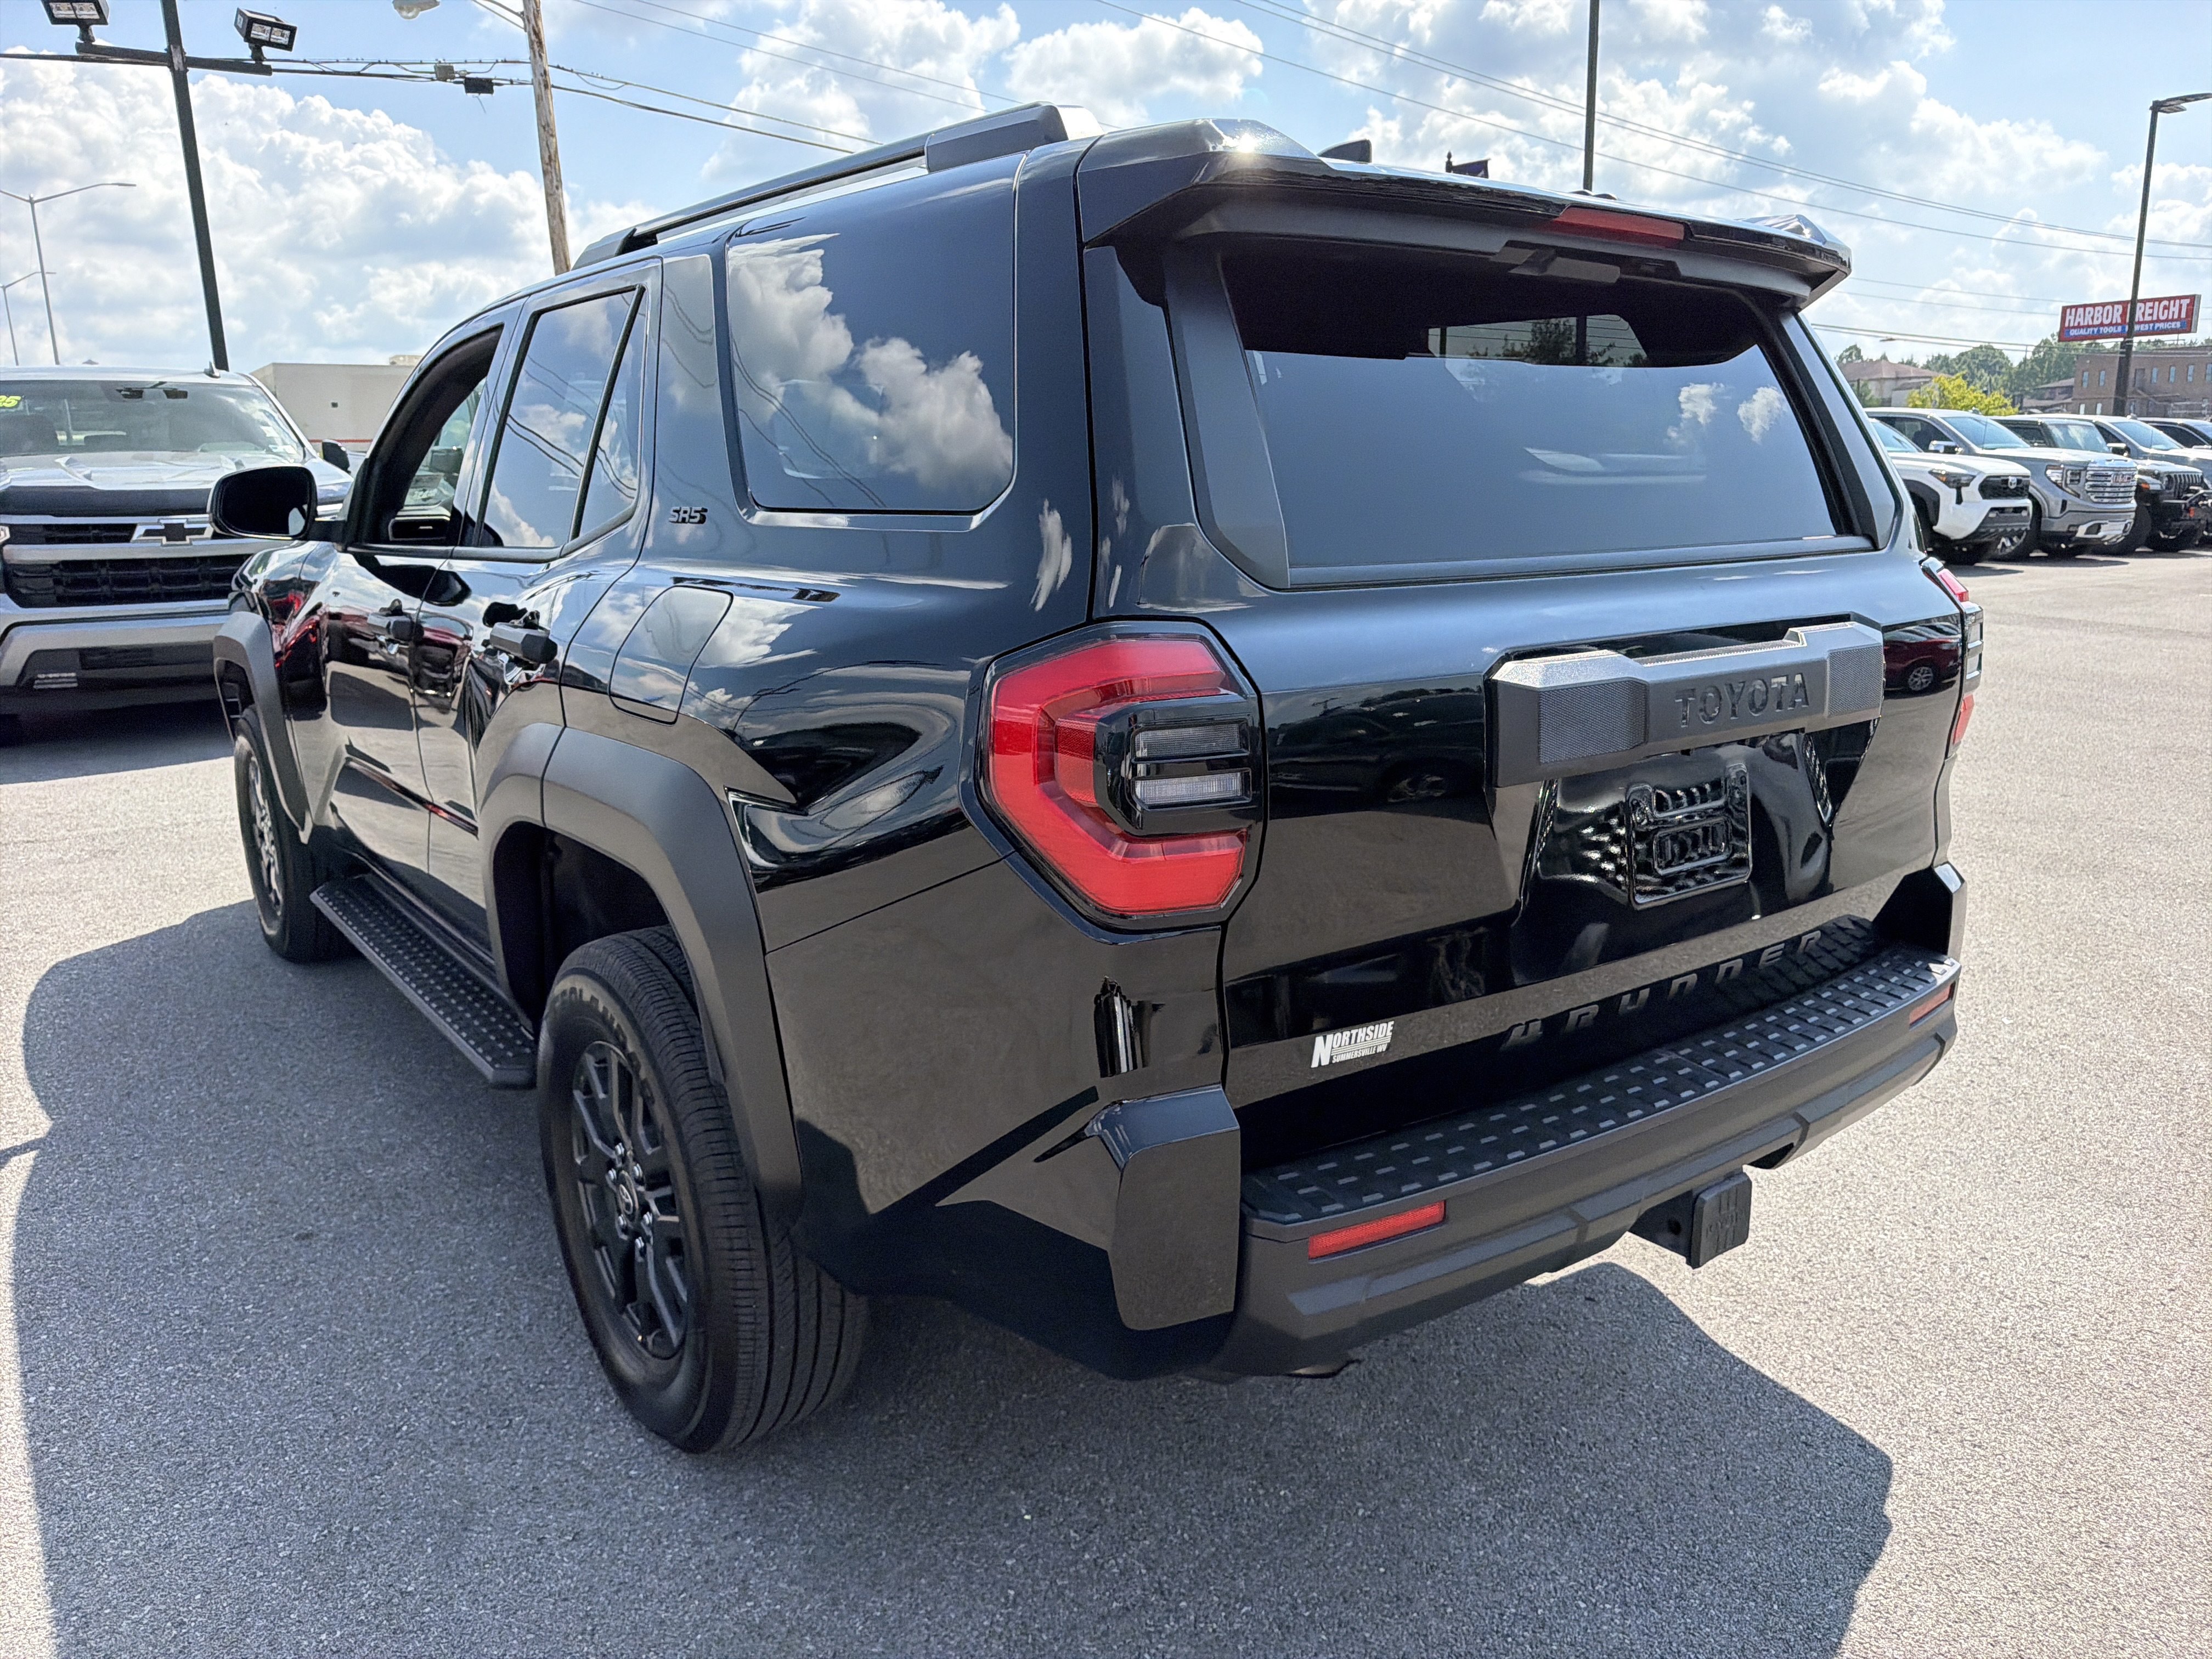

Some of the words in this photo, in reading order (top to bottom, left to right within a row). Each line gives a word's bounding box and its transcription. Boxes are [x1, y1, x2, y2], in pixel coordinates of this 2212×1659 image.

[2064, 304, 2123, 328] HARBOR
[2069, 328, 2097, 336] QUALITY
[2099, 325, 2122, 334] TOOLS
[2125, 323, 2154, 333] WEST
[2154, 321, 2181, 330] PRICES
[668, 506, 708, 524] SR5
[1674, 672, 1809, 729] TOYOTA
[1310, 1020, 1395, 1068] NORTHSIDE
[1331, 1047, 1376, 1064] SUMMERSVILLE
[1376, 1043, 1388, 1053] WV
